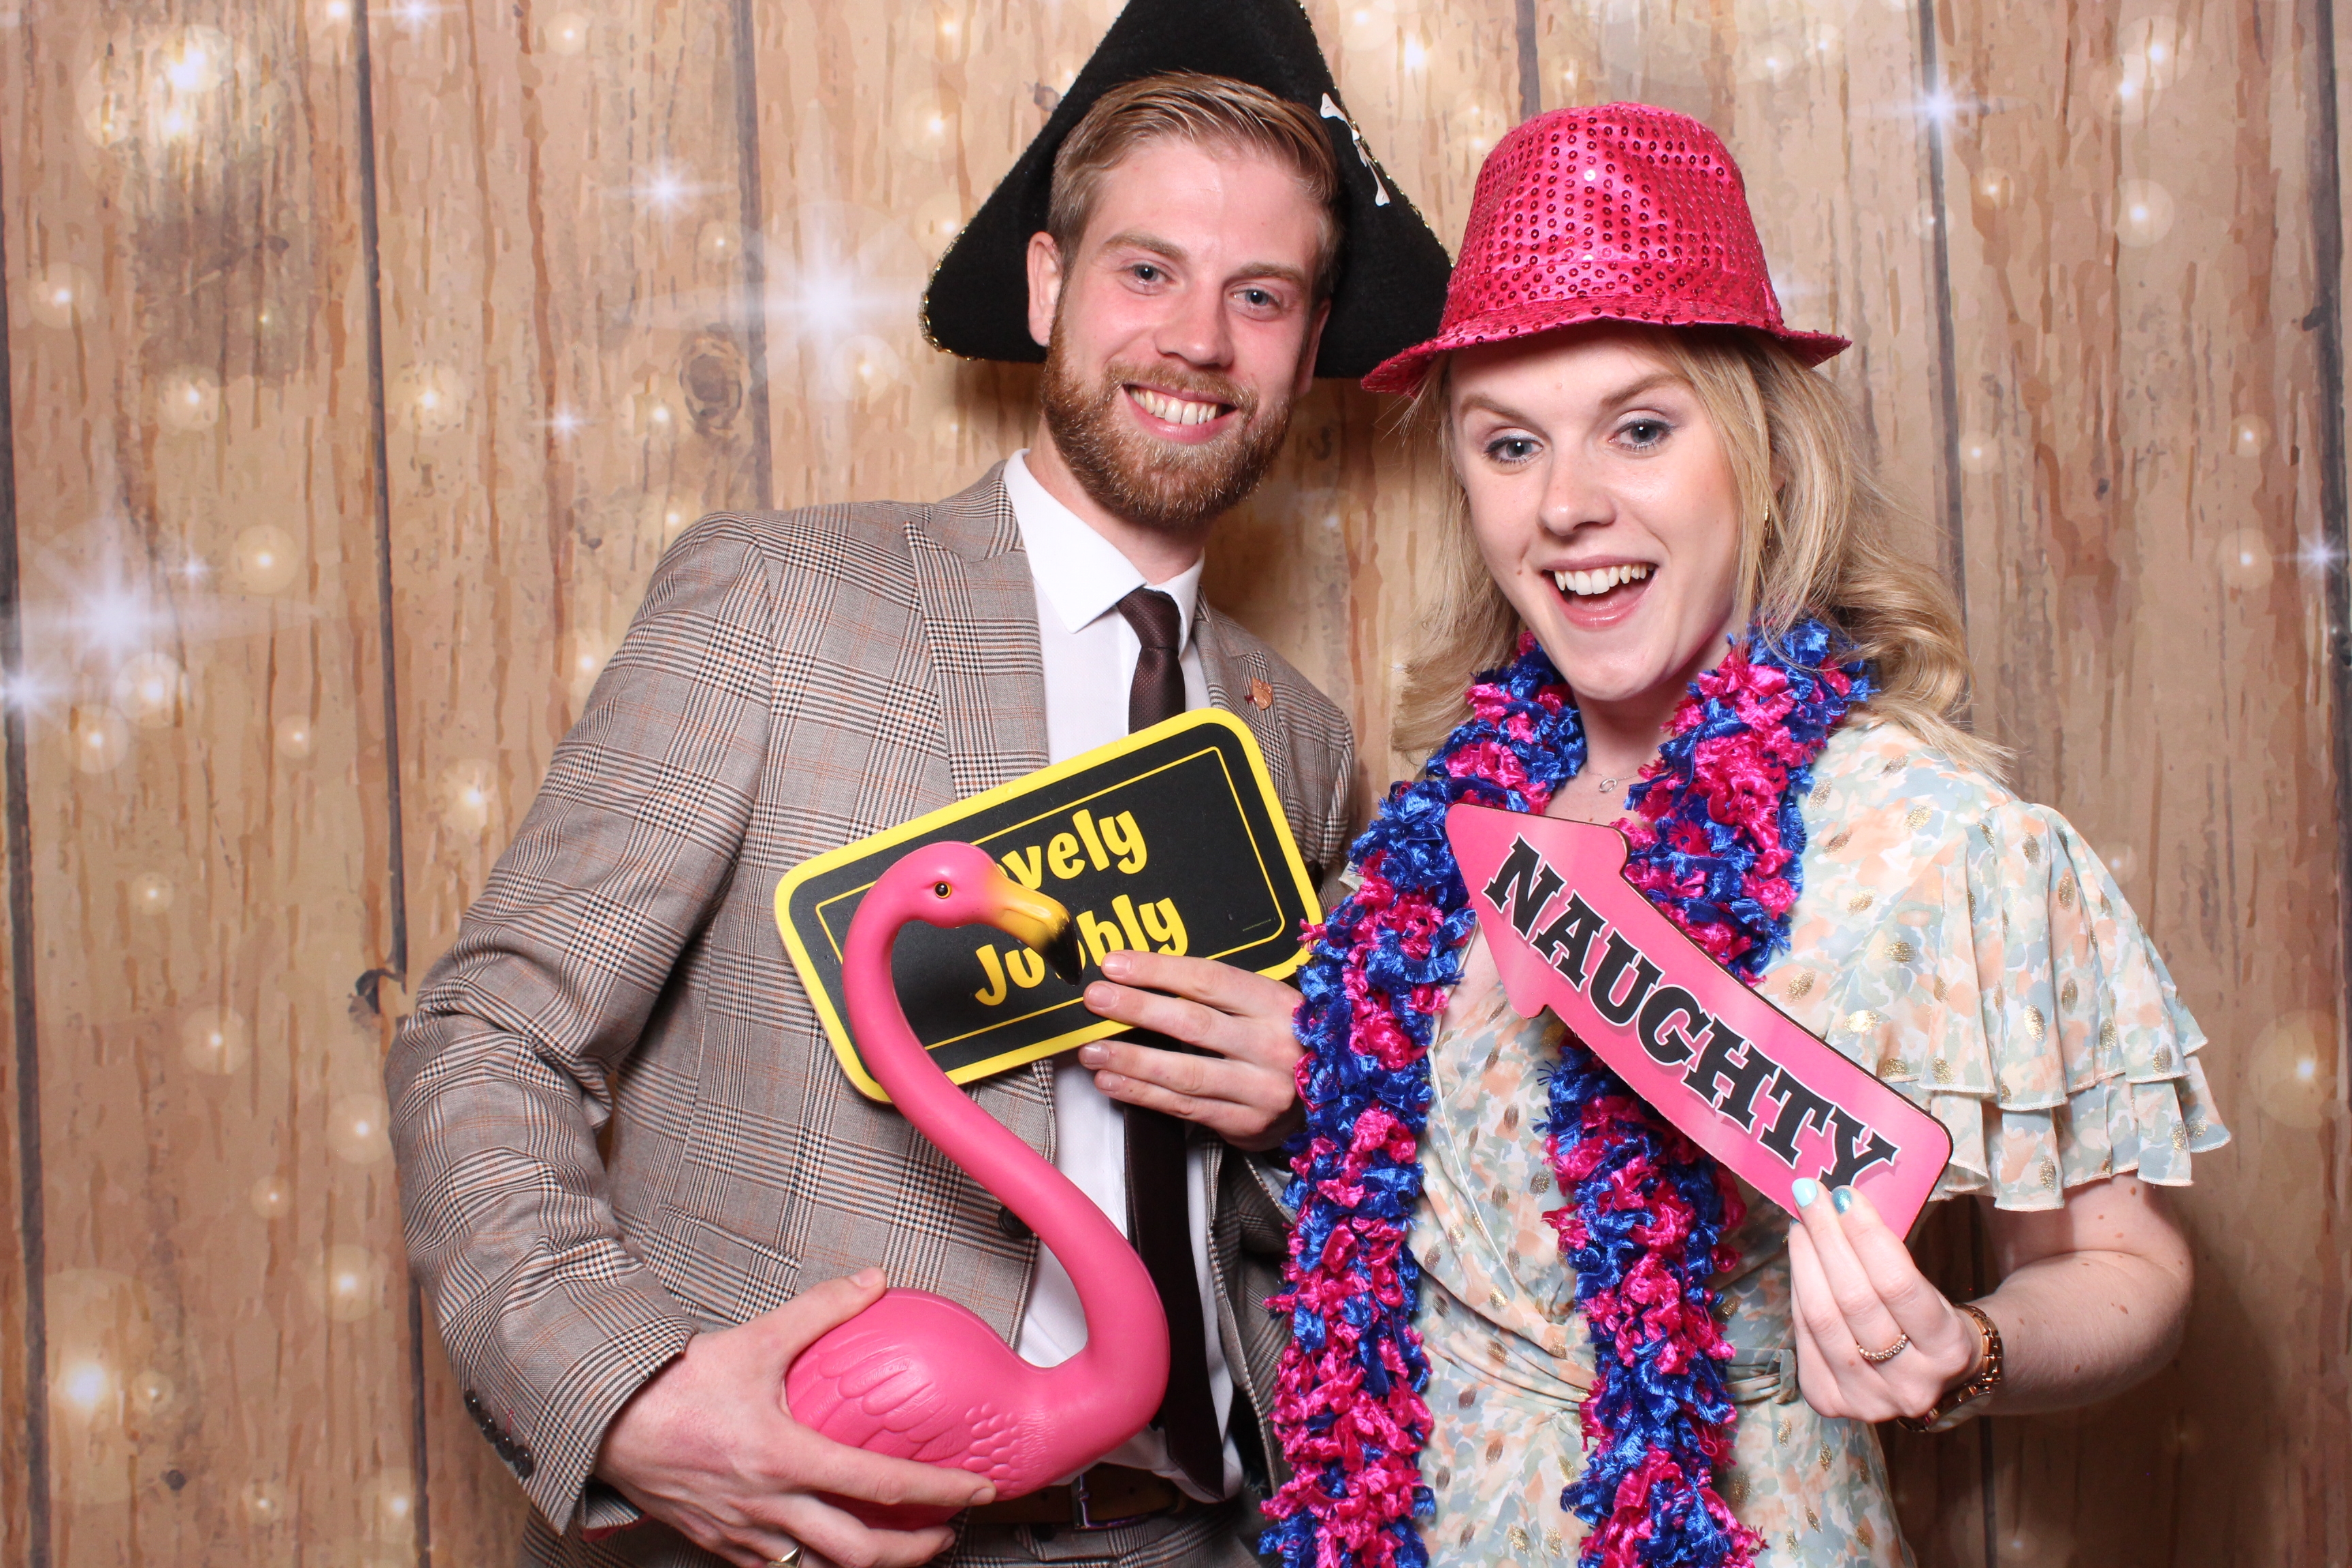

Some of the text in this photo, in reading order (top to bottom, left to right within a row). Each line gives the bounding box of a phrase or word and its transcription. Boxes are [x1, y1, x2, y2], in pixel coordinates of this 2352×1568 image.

[996, 808, 1147, 890] vely
[975, 894, 1188, 1006] Jubly
[1482, 833, 1900, 1193] NAUGHTY
